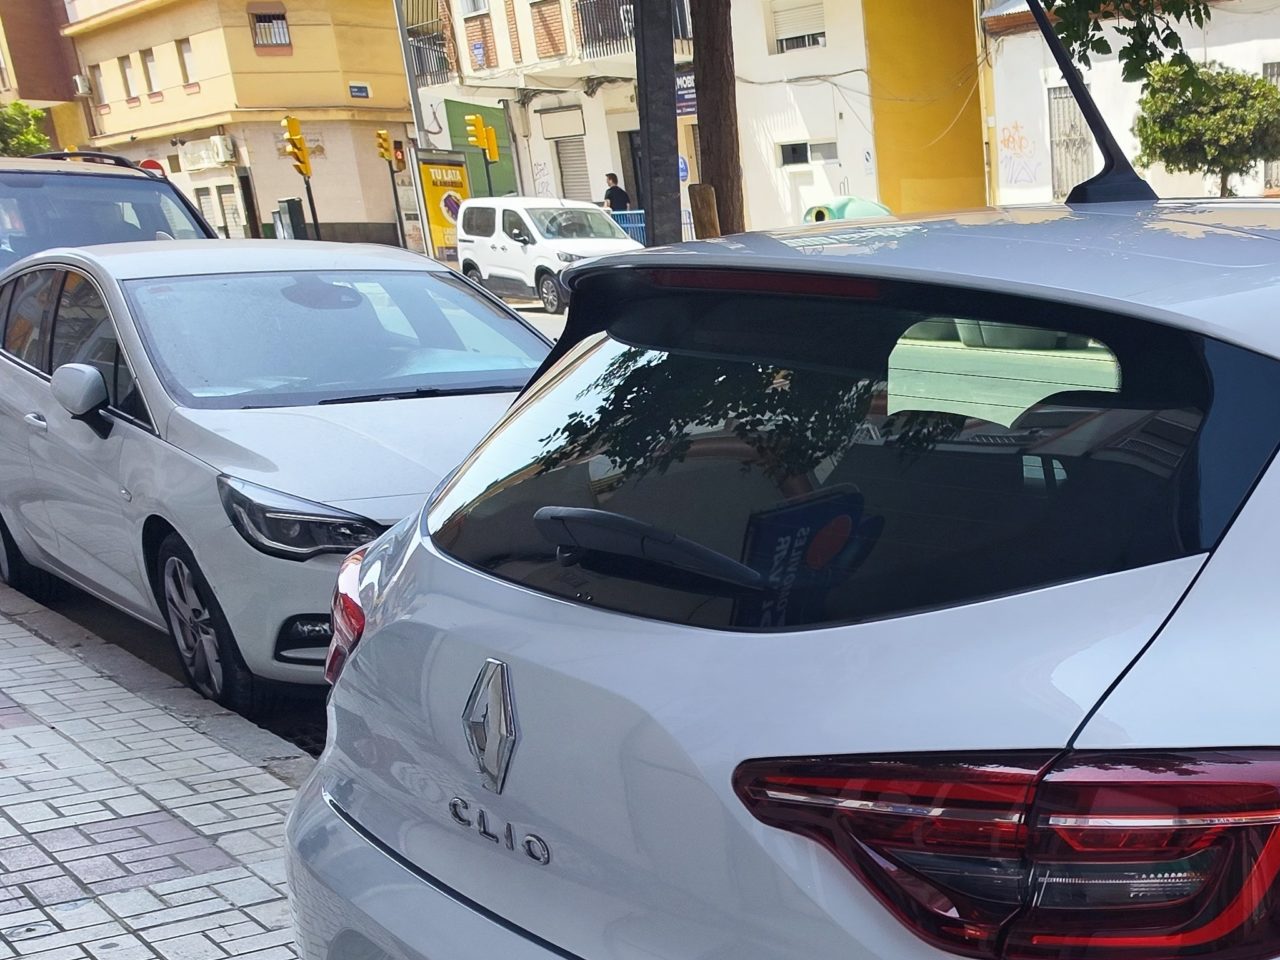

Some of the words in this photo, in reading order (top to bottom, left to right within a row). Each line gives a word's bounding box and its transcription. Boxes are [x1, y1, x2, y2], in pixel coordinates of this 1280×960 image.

[429, 168, 442, 180] TU
[443, 168, 462, 181] LATA
[448, 796, 551, 866] CLIO
